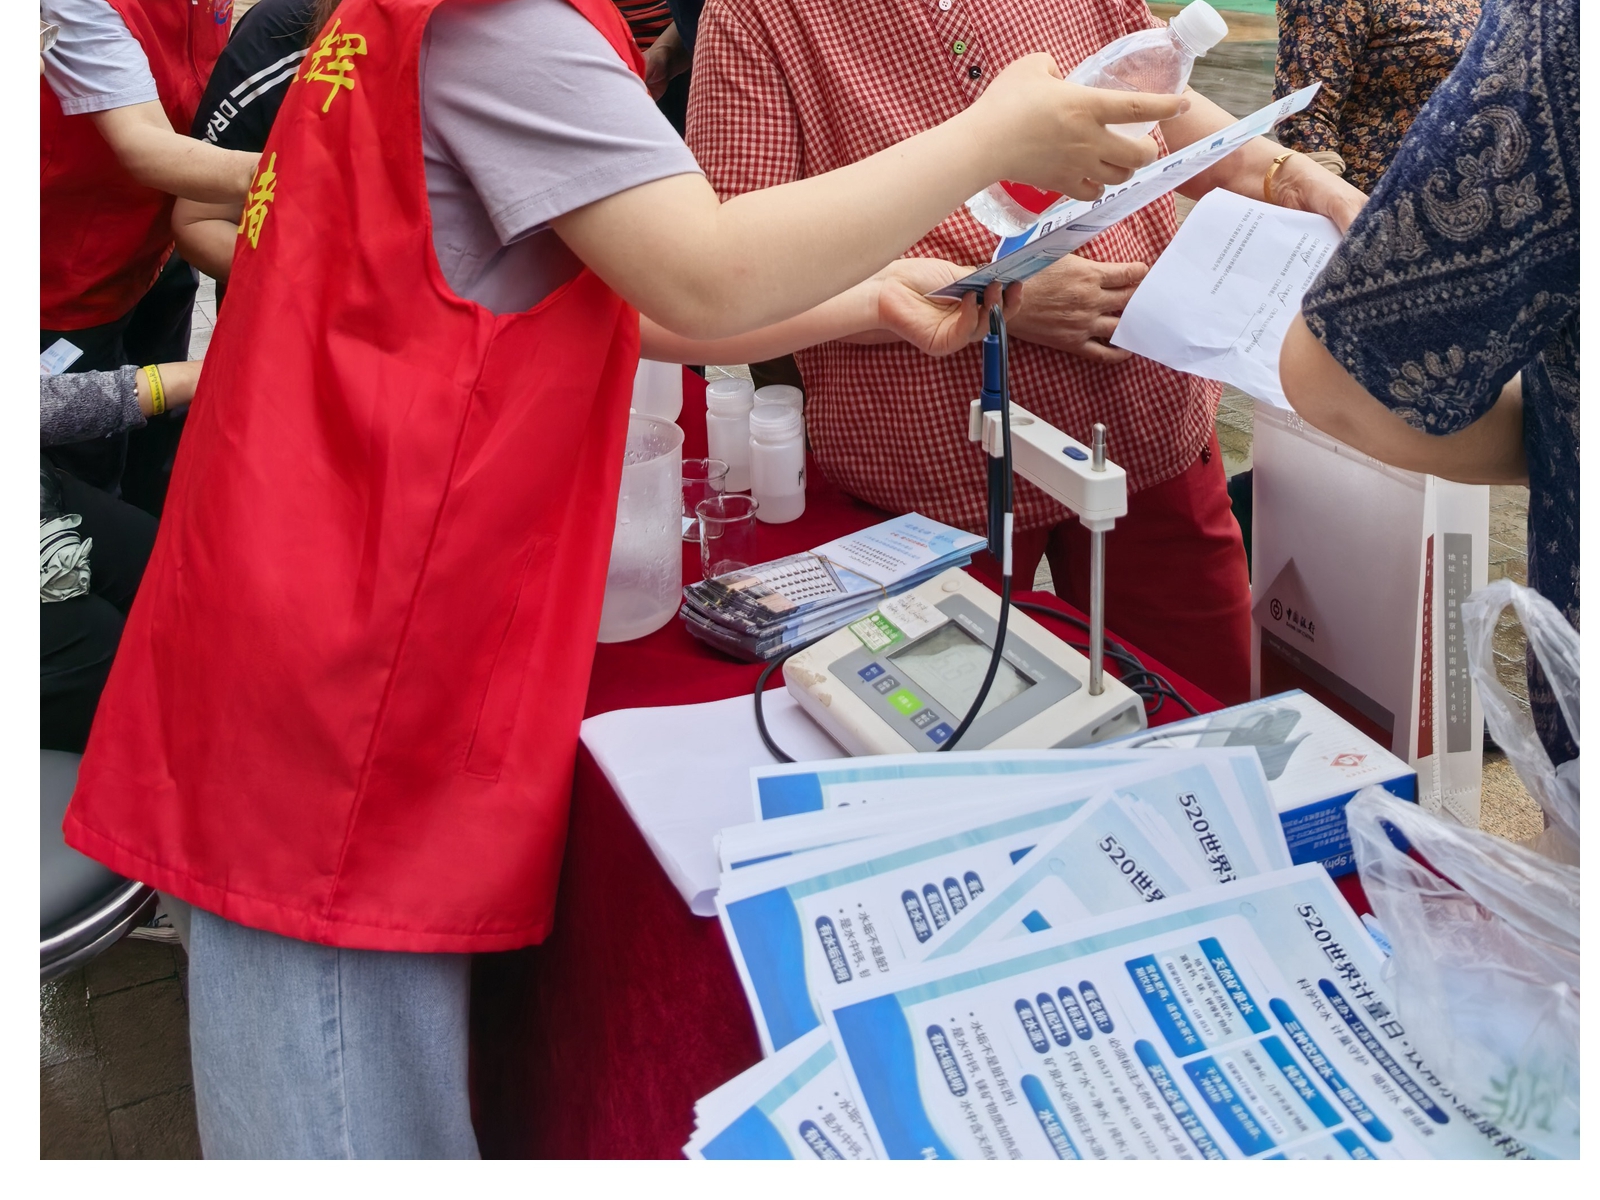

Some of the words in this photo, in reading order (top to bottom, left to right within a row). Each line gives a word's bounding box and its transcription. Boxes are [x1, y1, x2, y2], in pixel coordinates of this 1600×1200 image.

[293, 19, 368, 113] 辉
[199, 98, 238, 144] DRA
[237, 152, 277, 249] 者
[945, 885, 965, 914] 看标
[1209, 956, 1257, 1015] 天然矿泉水
[1295, 977, 1334, 1022] 科学饮水
[1283, 1019, 1336, 1079] 三种饮用水
[1146, 1063, 1189, 1115] 买水必看
[1281, 1063, 1318, 1100] 纯净水
